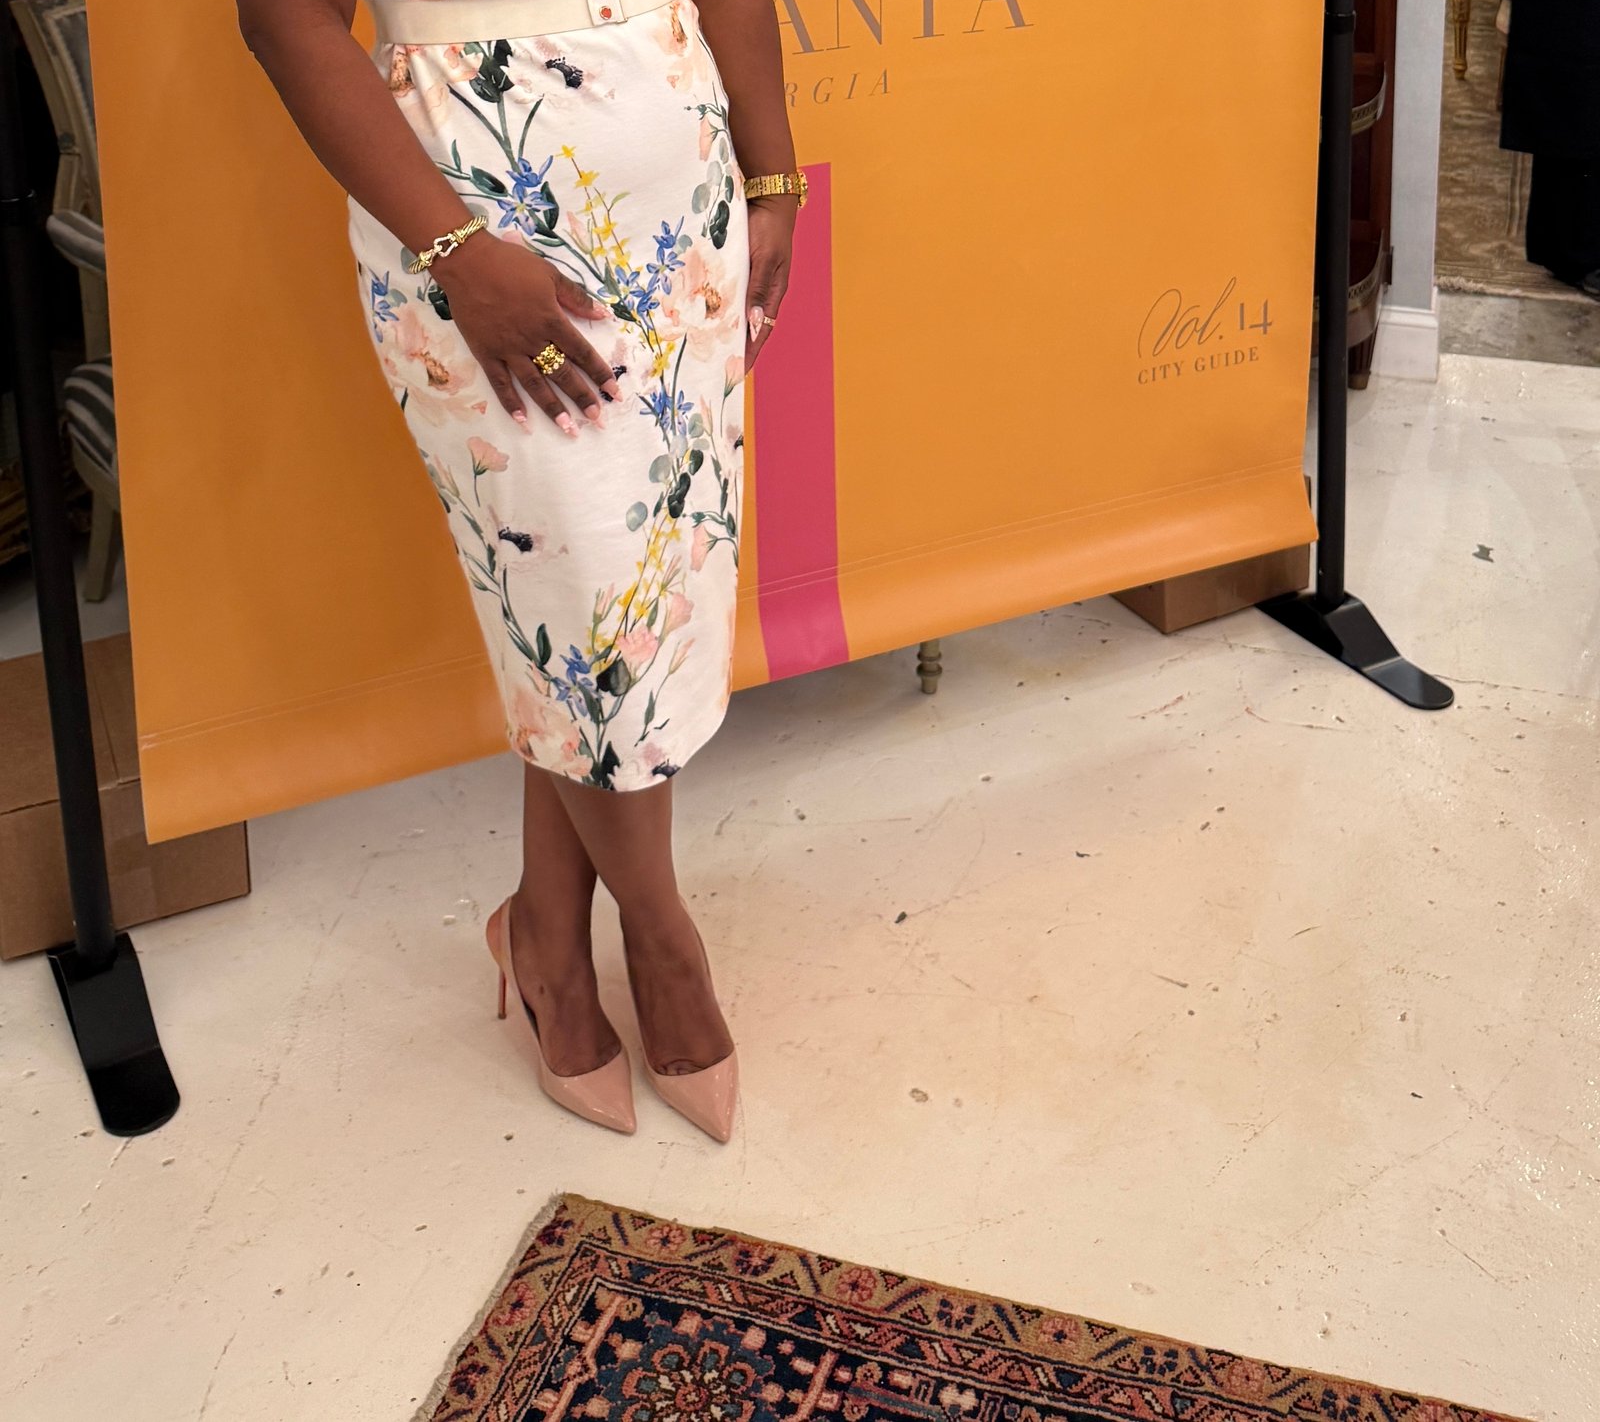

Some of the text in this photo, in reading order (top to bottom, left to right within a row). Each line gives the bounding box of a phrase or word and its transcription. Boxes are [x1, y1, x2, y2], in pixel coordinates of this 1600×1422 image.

[1137, 276, 1273, 359] Vol. 14
[1137, 345, 1260, 386] CITY GUIDE
